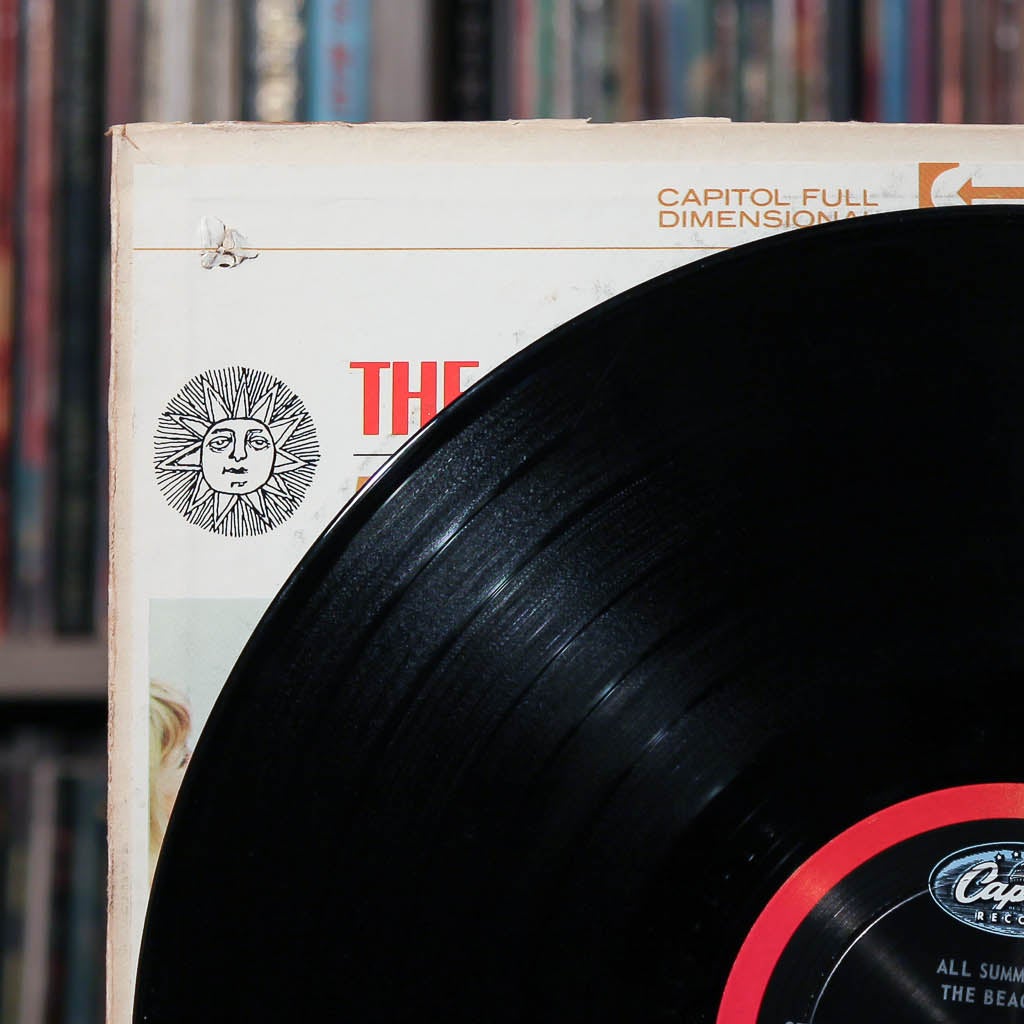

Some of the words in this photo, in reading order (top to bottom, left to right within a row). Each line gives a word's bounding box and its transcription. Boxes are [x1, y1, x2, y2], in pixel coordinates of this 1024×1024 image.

[657, 188, 790, 207] CAPITOL
[802, 188, 878, 207] FULL
[936, 958, 972, 978] ALL
[941, 984, 976, 1004] THE
